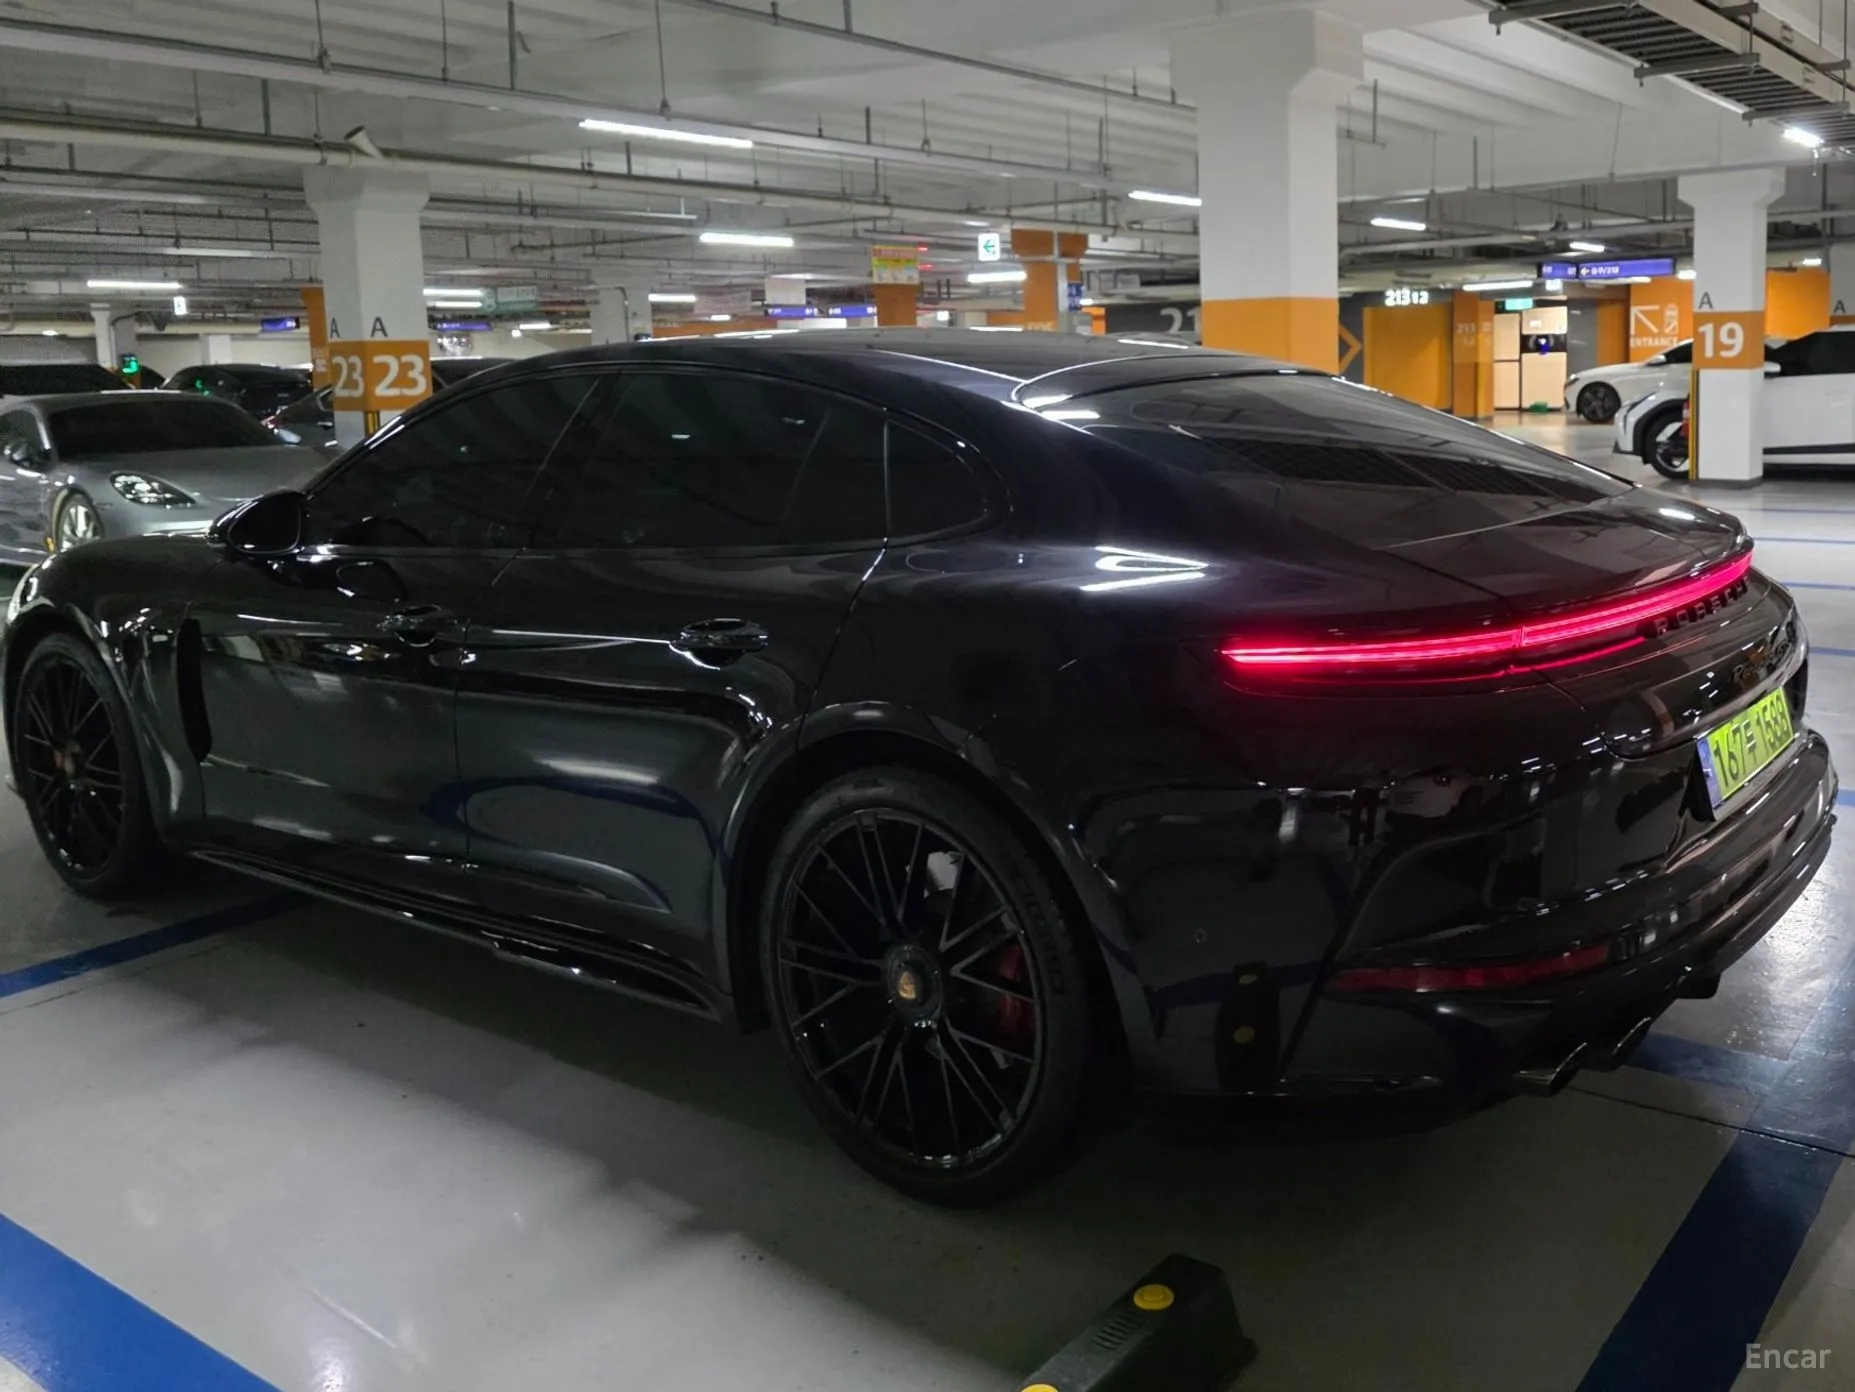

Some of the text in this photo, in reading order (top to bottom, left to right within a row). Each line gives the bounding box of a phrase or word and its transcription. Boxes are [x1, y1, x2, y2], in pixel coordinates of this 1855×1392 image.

[1699, 292, 1713, 309] A
[1833, 300, 1846, 313] A
[330, 317, 340, 339] A
[371, 316, 388, 338] A
[1698, 321, 1744, 359] 19
[331, 354, 365, 398] 23
[372, 354, 427, 397] 23
